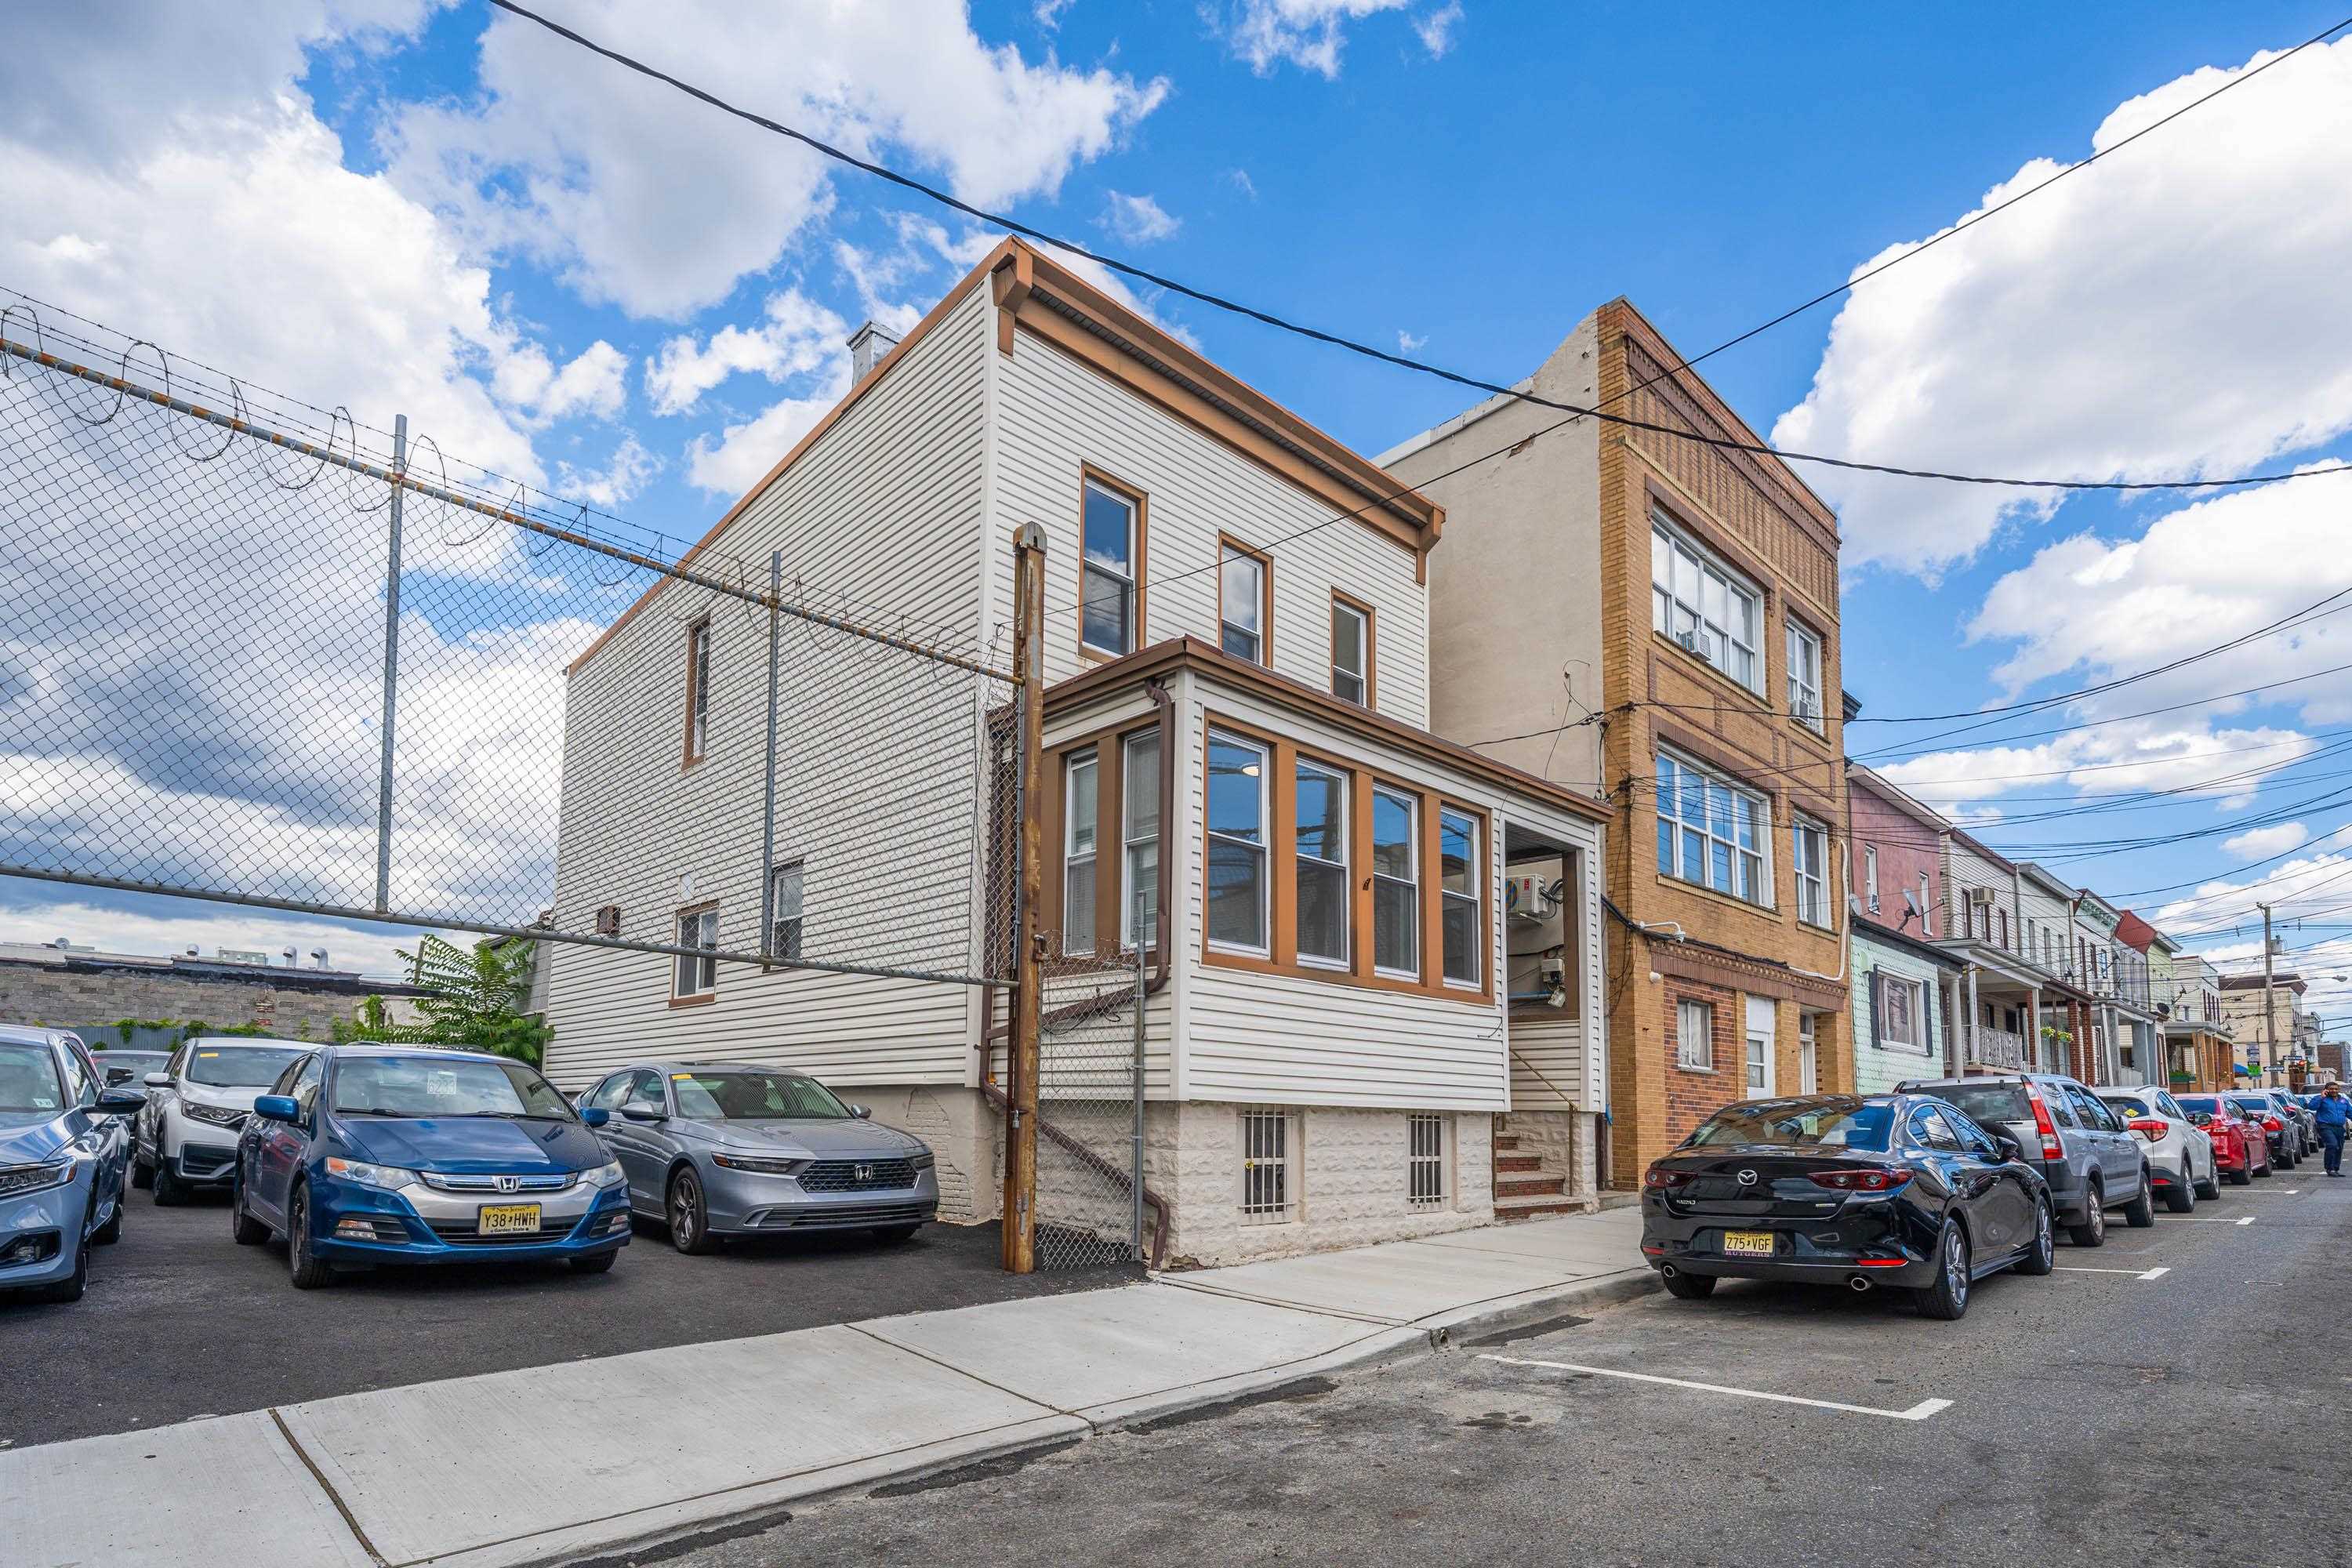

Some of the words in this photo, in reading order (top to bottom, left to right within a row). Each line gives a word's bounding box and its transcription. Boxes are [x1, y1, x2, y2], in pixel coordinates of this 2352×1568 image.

[485, 1213, 506, 1228] Y38
[514, 1212, 536, 1226] HWH
[1752, 1238, 1771, 1250] VGF
